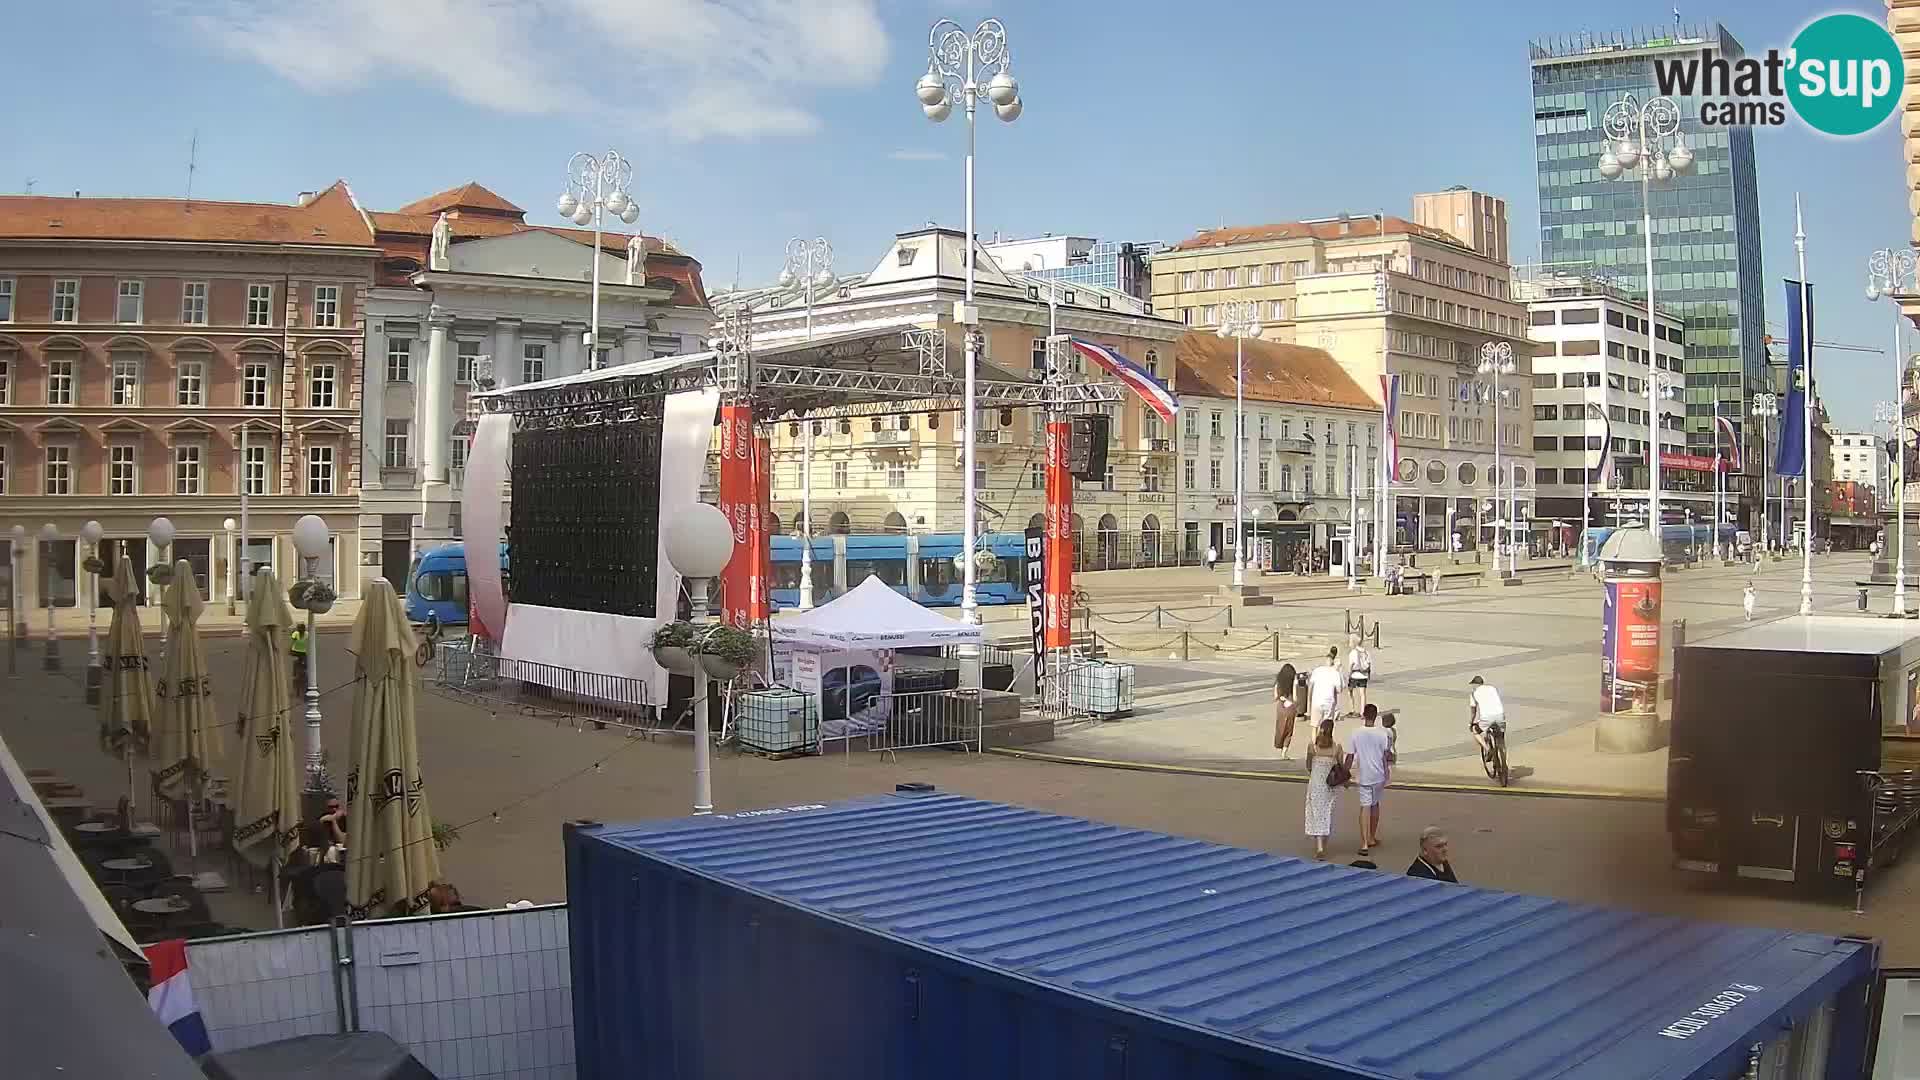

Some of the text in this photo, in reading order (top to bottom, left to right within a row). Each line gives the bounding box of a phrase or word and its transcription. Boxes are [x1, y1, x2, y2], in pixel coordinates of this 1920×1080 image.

[735, 419, 748, 460] Coca-Cola
[735, 503, 747, 544] Coca-Cola
[1061, 504, 1070, 538] Coca-Cola
[1658, 1017, 1708, 1039] MCDU
[1691, 991, 1747, 1018] 300629
